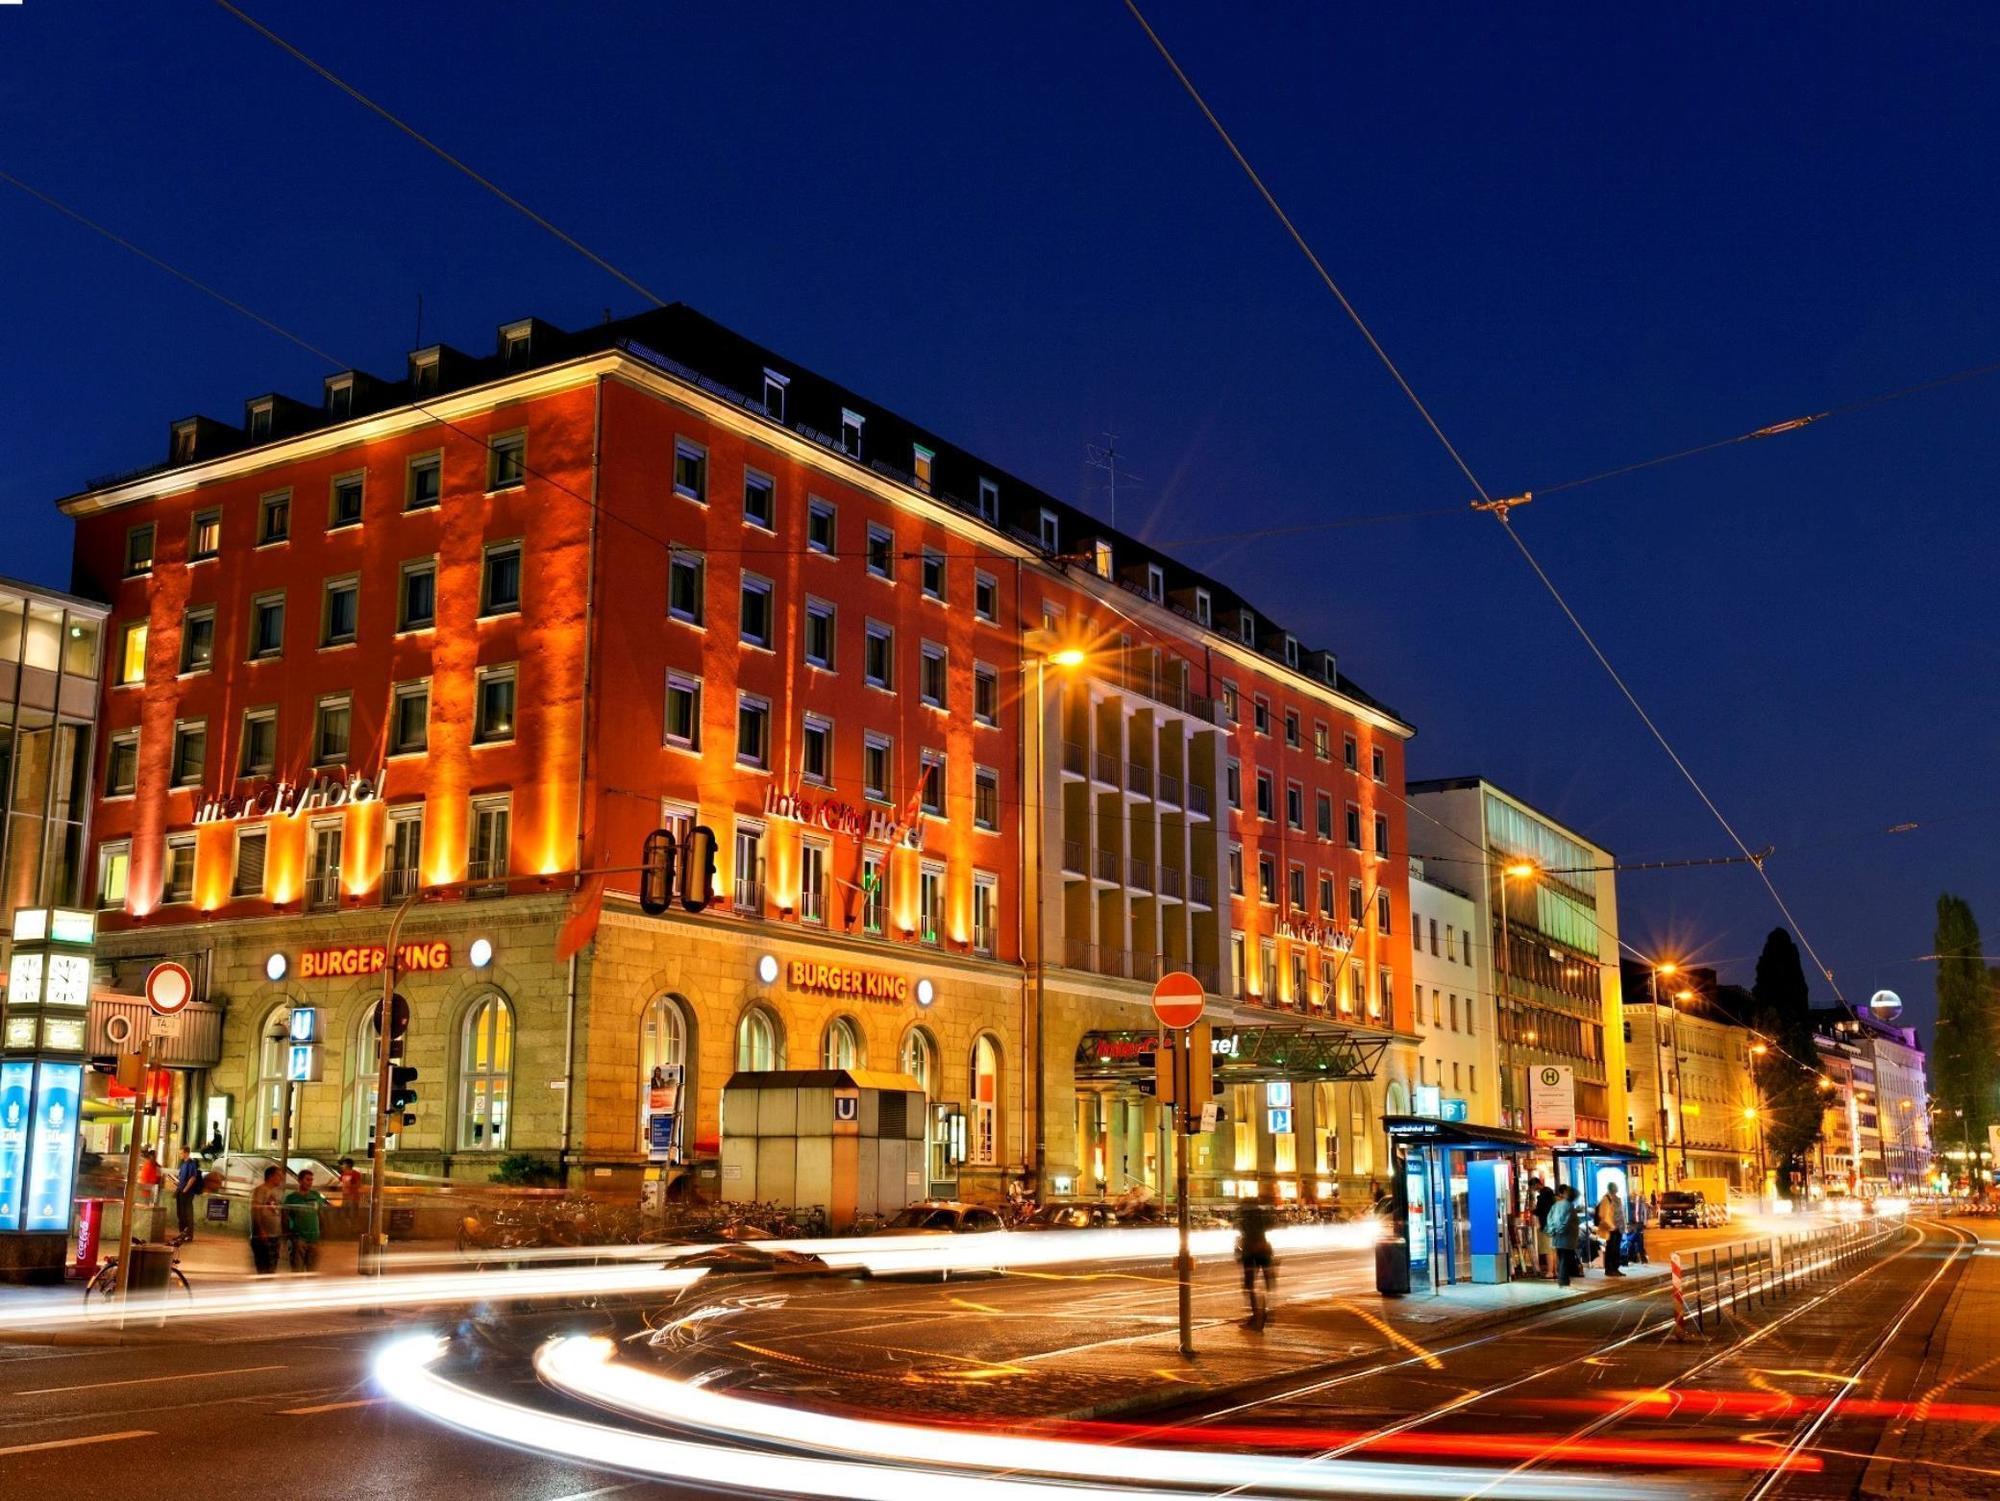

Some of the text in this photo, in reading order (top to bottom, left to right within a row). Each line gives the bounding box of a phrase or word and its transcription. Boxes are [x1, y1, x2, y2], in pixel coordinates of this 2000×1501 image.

[300, 943, 447, 977] BURGER ING
[791, 960, 906, 1000] BURGER KING
[1545, 1071, 1555, 1082] H
[838, 1099, 855, 1120] U
